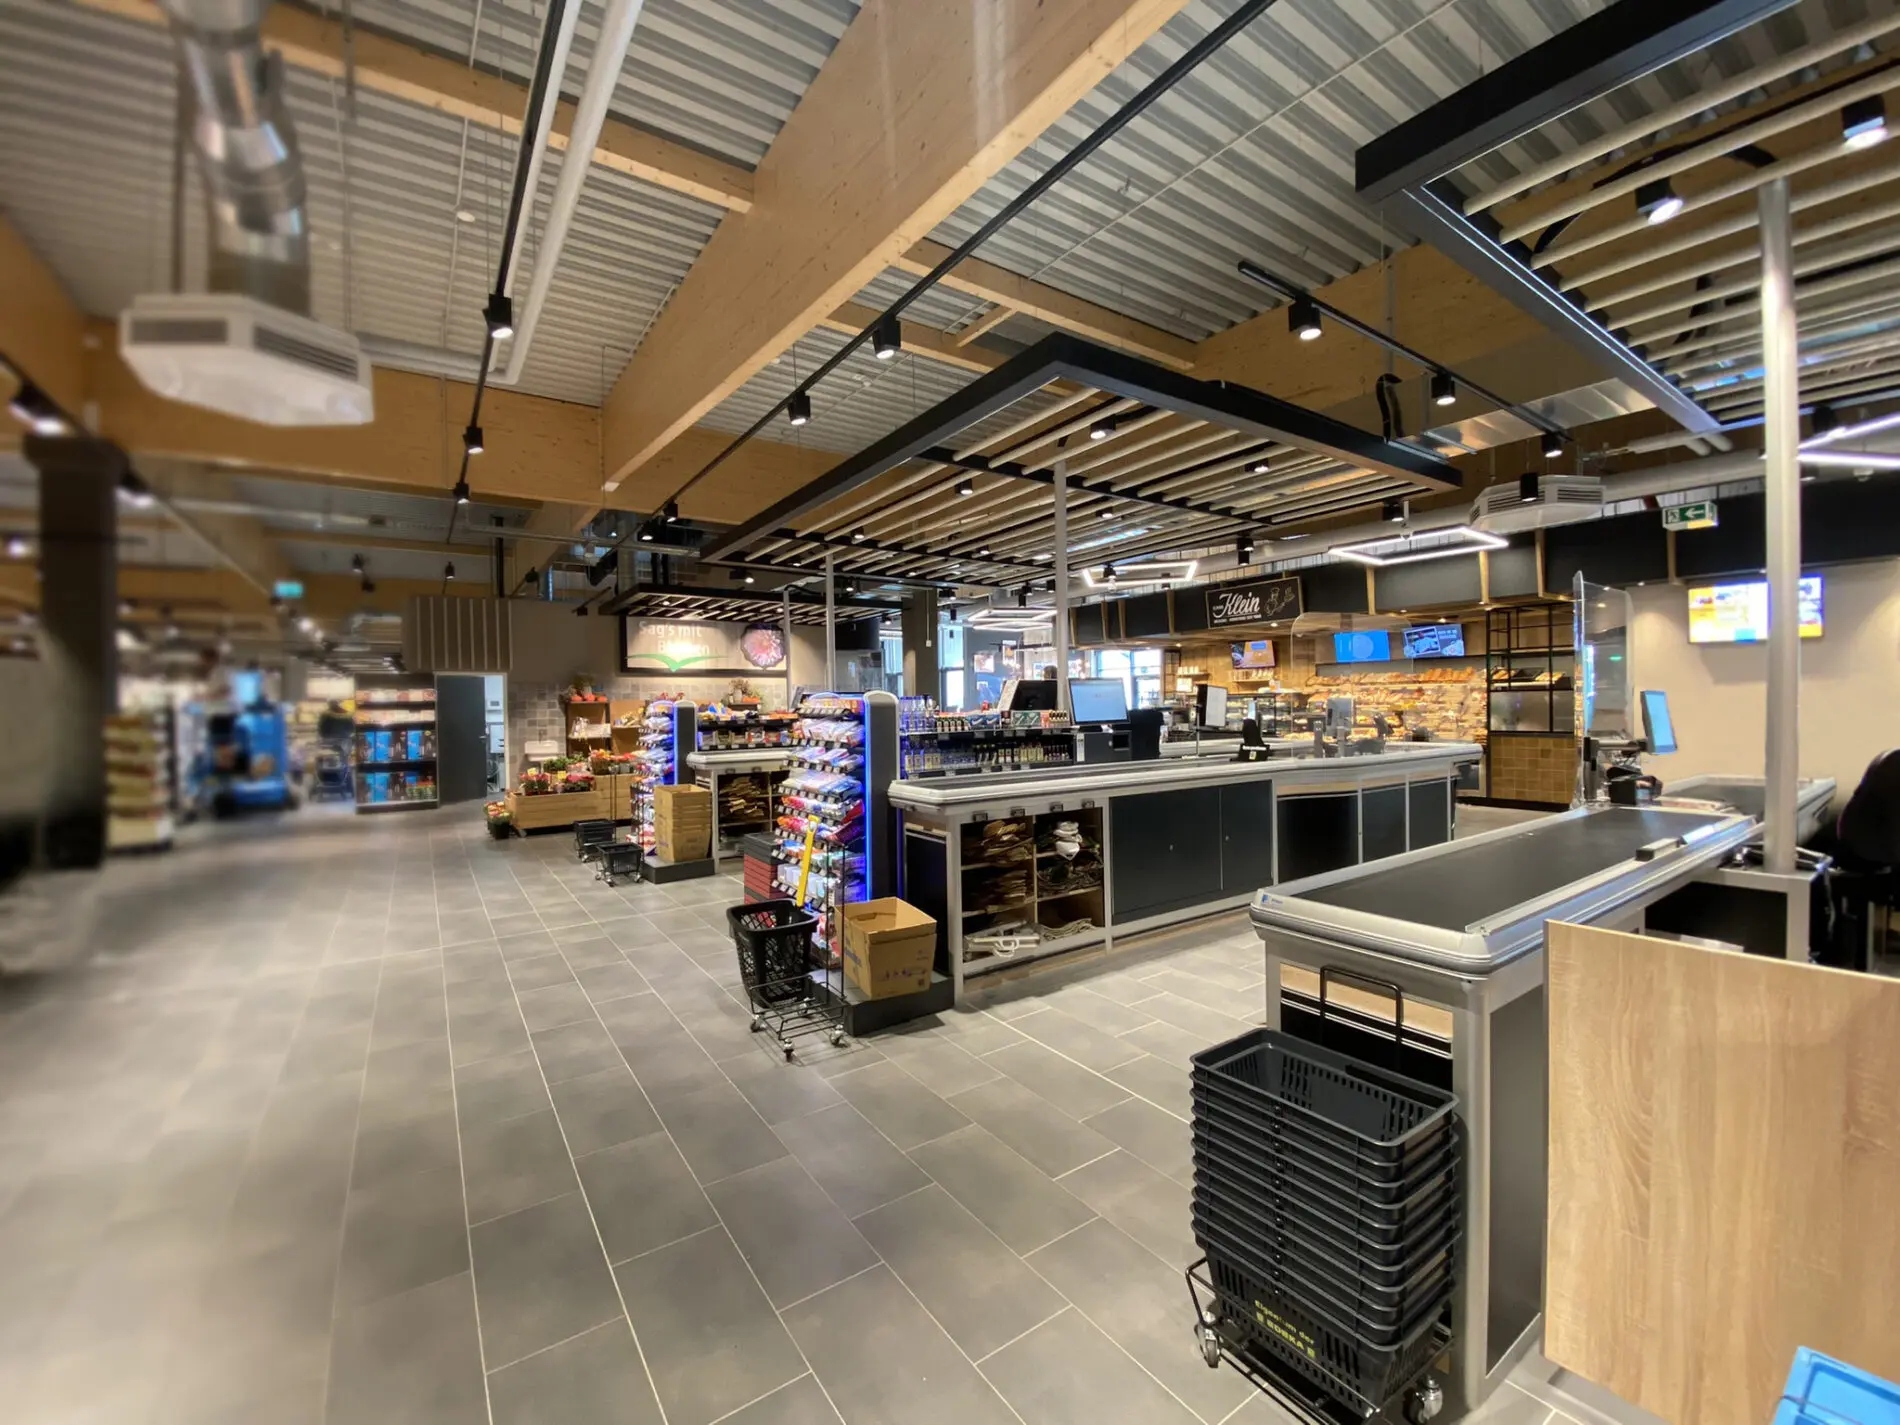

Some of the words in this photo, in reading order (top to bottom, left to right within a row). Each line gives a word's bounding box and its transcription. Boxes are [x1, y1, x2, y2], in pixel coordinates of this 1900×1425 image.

[1213, 592, 1260, 618] Klein
[639, 621, 675, 638] Sag's
[678, 624, 702, 638] mit
[1266, 1319, 1304, 1351] EDEKA
